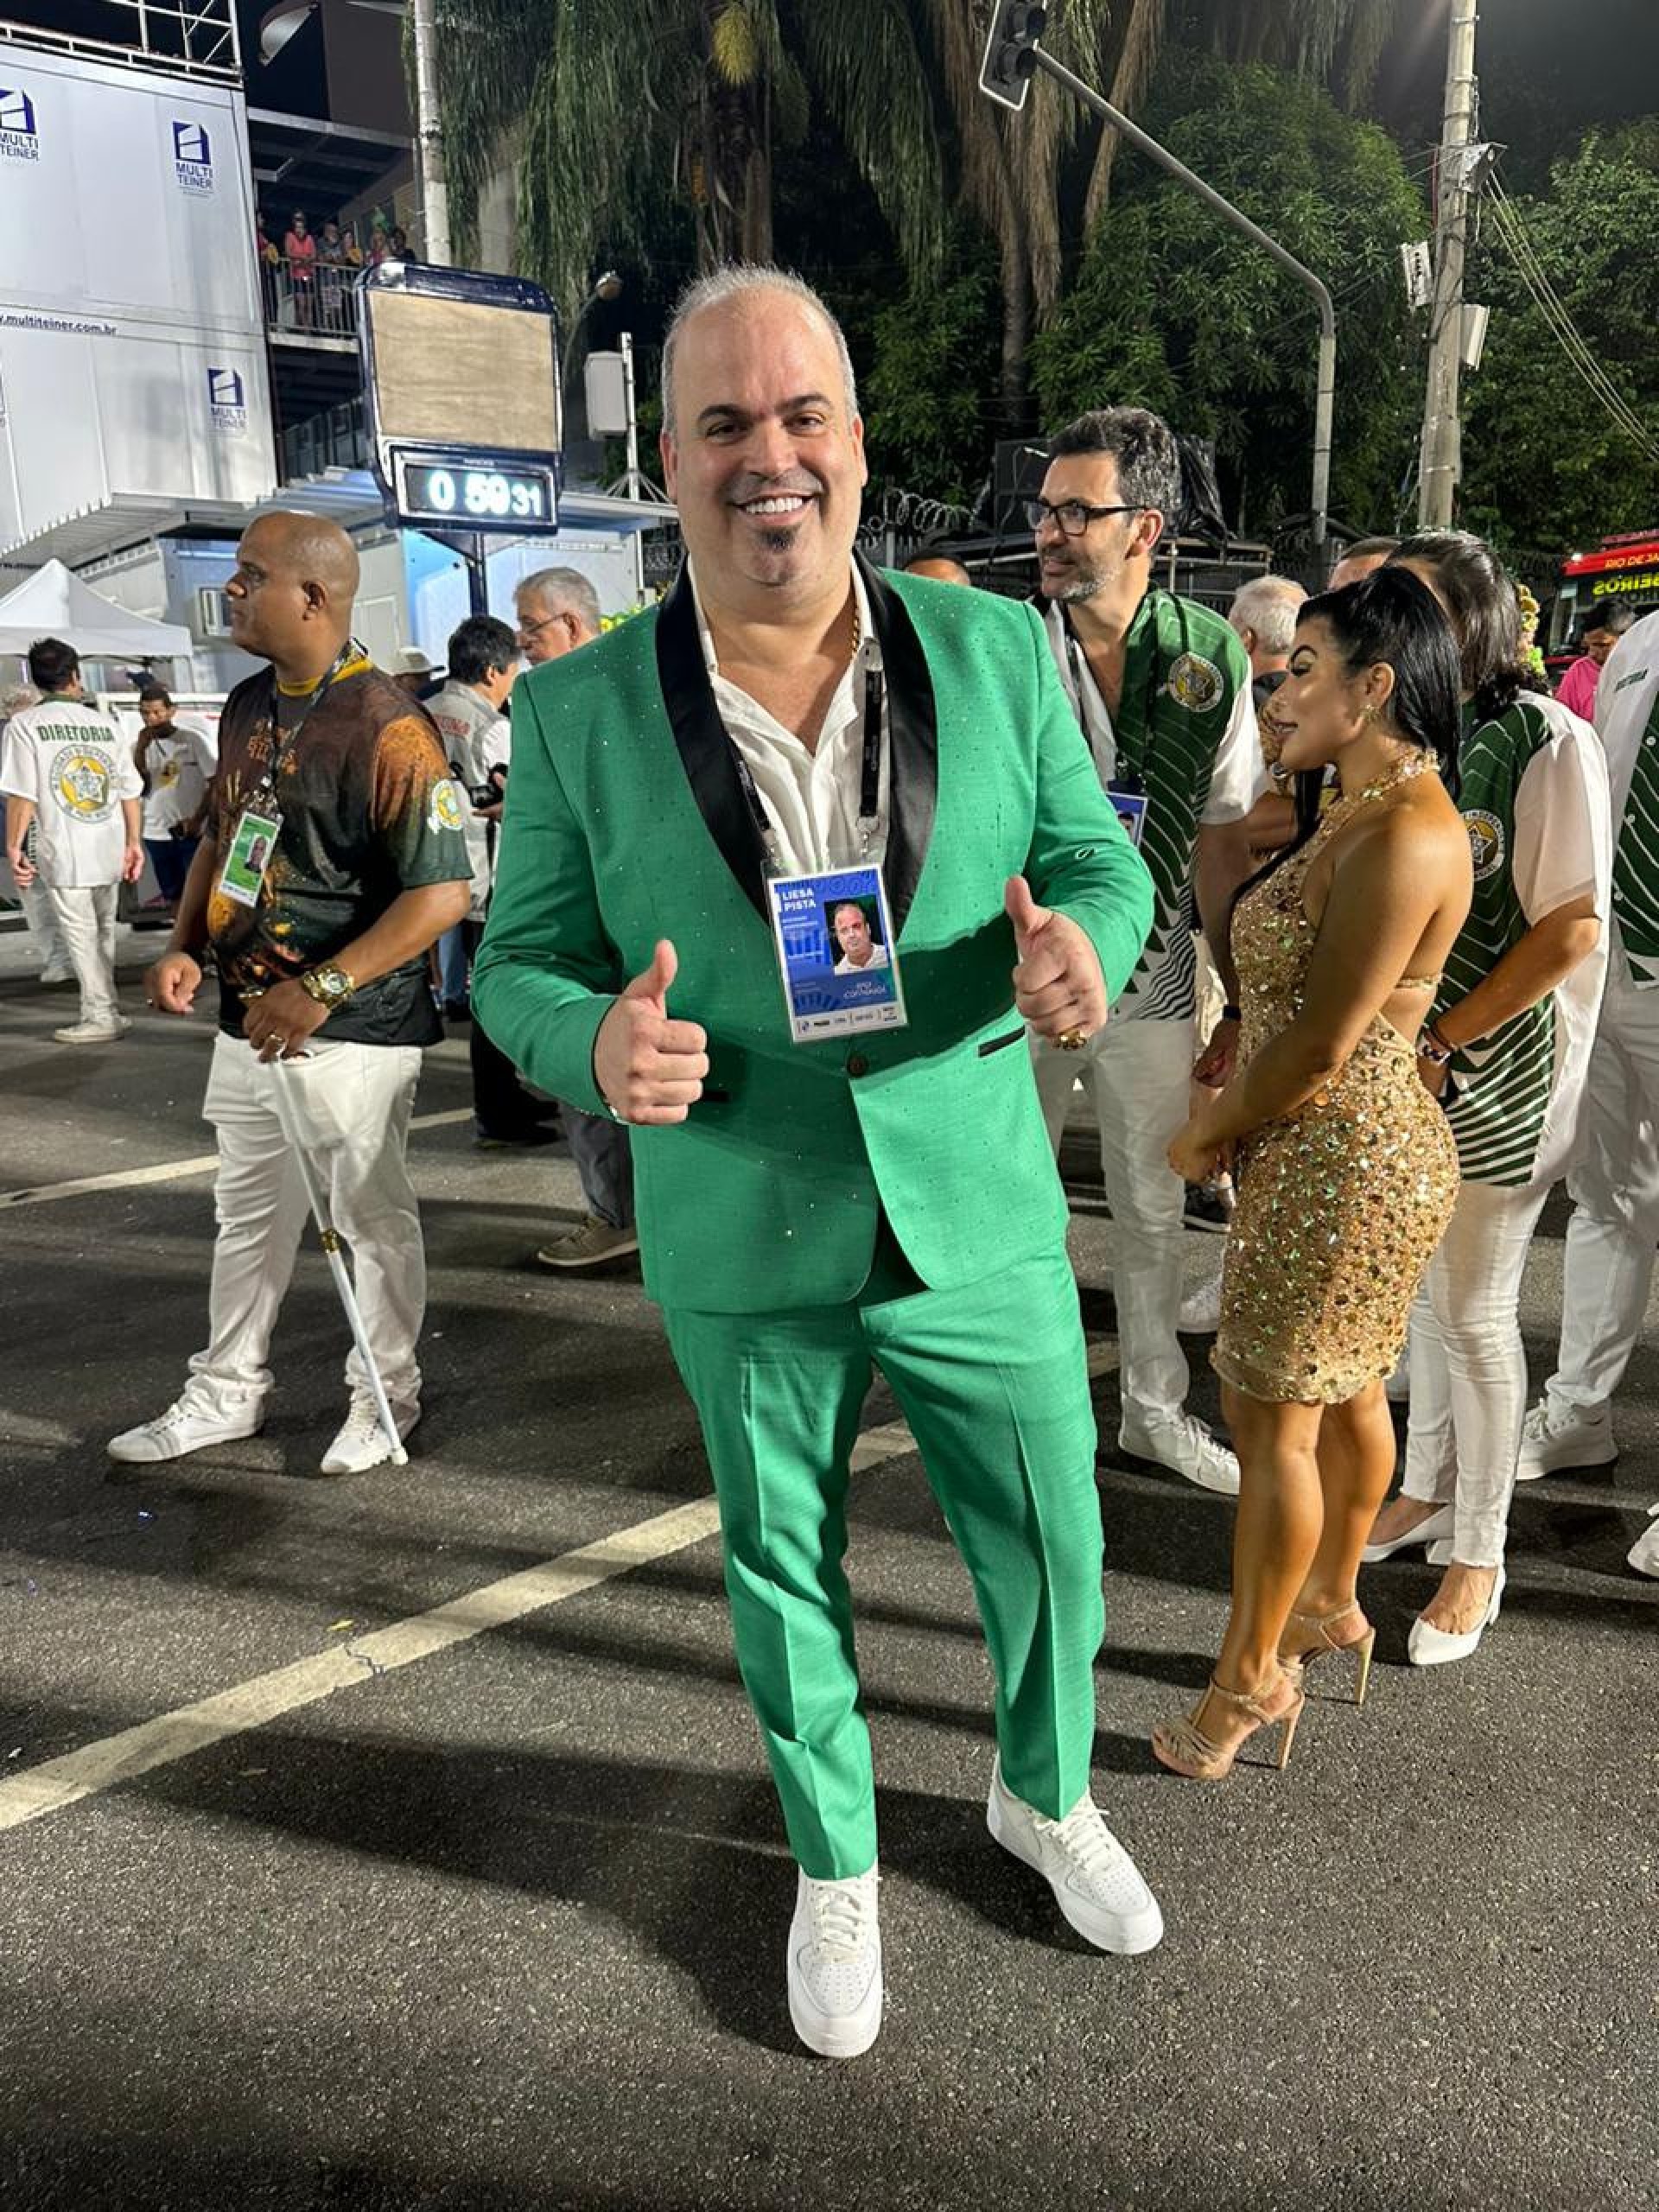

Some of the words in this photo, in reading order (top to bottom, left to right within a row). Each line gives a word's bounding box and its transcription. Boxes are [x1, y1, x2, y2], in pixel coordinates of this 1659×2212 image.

[0, 132, 39, 149] MULTI
[175, 162, 213, 179] MULTI
[177, 175, 213, 189] TEINER
[210, 406, 247, 419] MULTI
[429, 469, 455, 511] 0
[512, 483, 543, 517] 31
[36, 724, 116, 742] DIRETORIA
[782, 887, 815, 901] LIESA
[784, 899, 817, 912] PISTA
